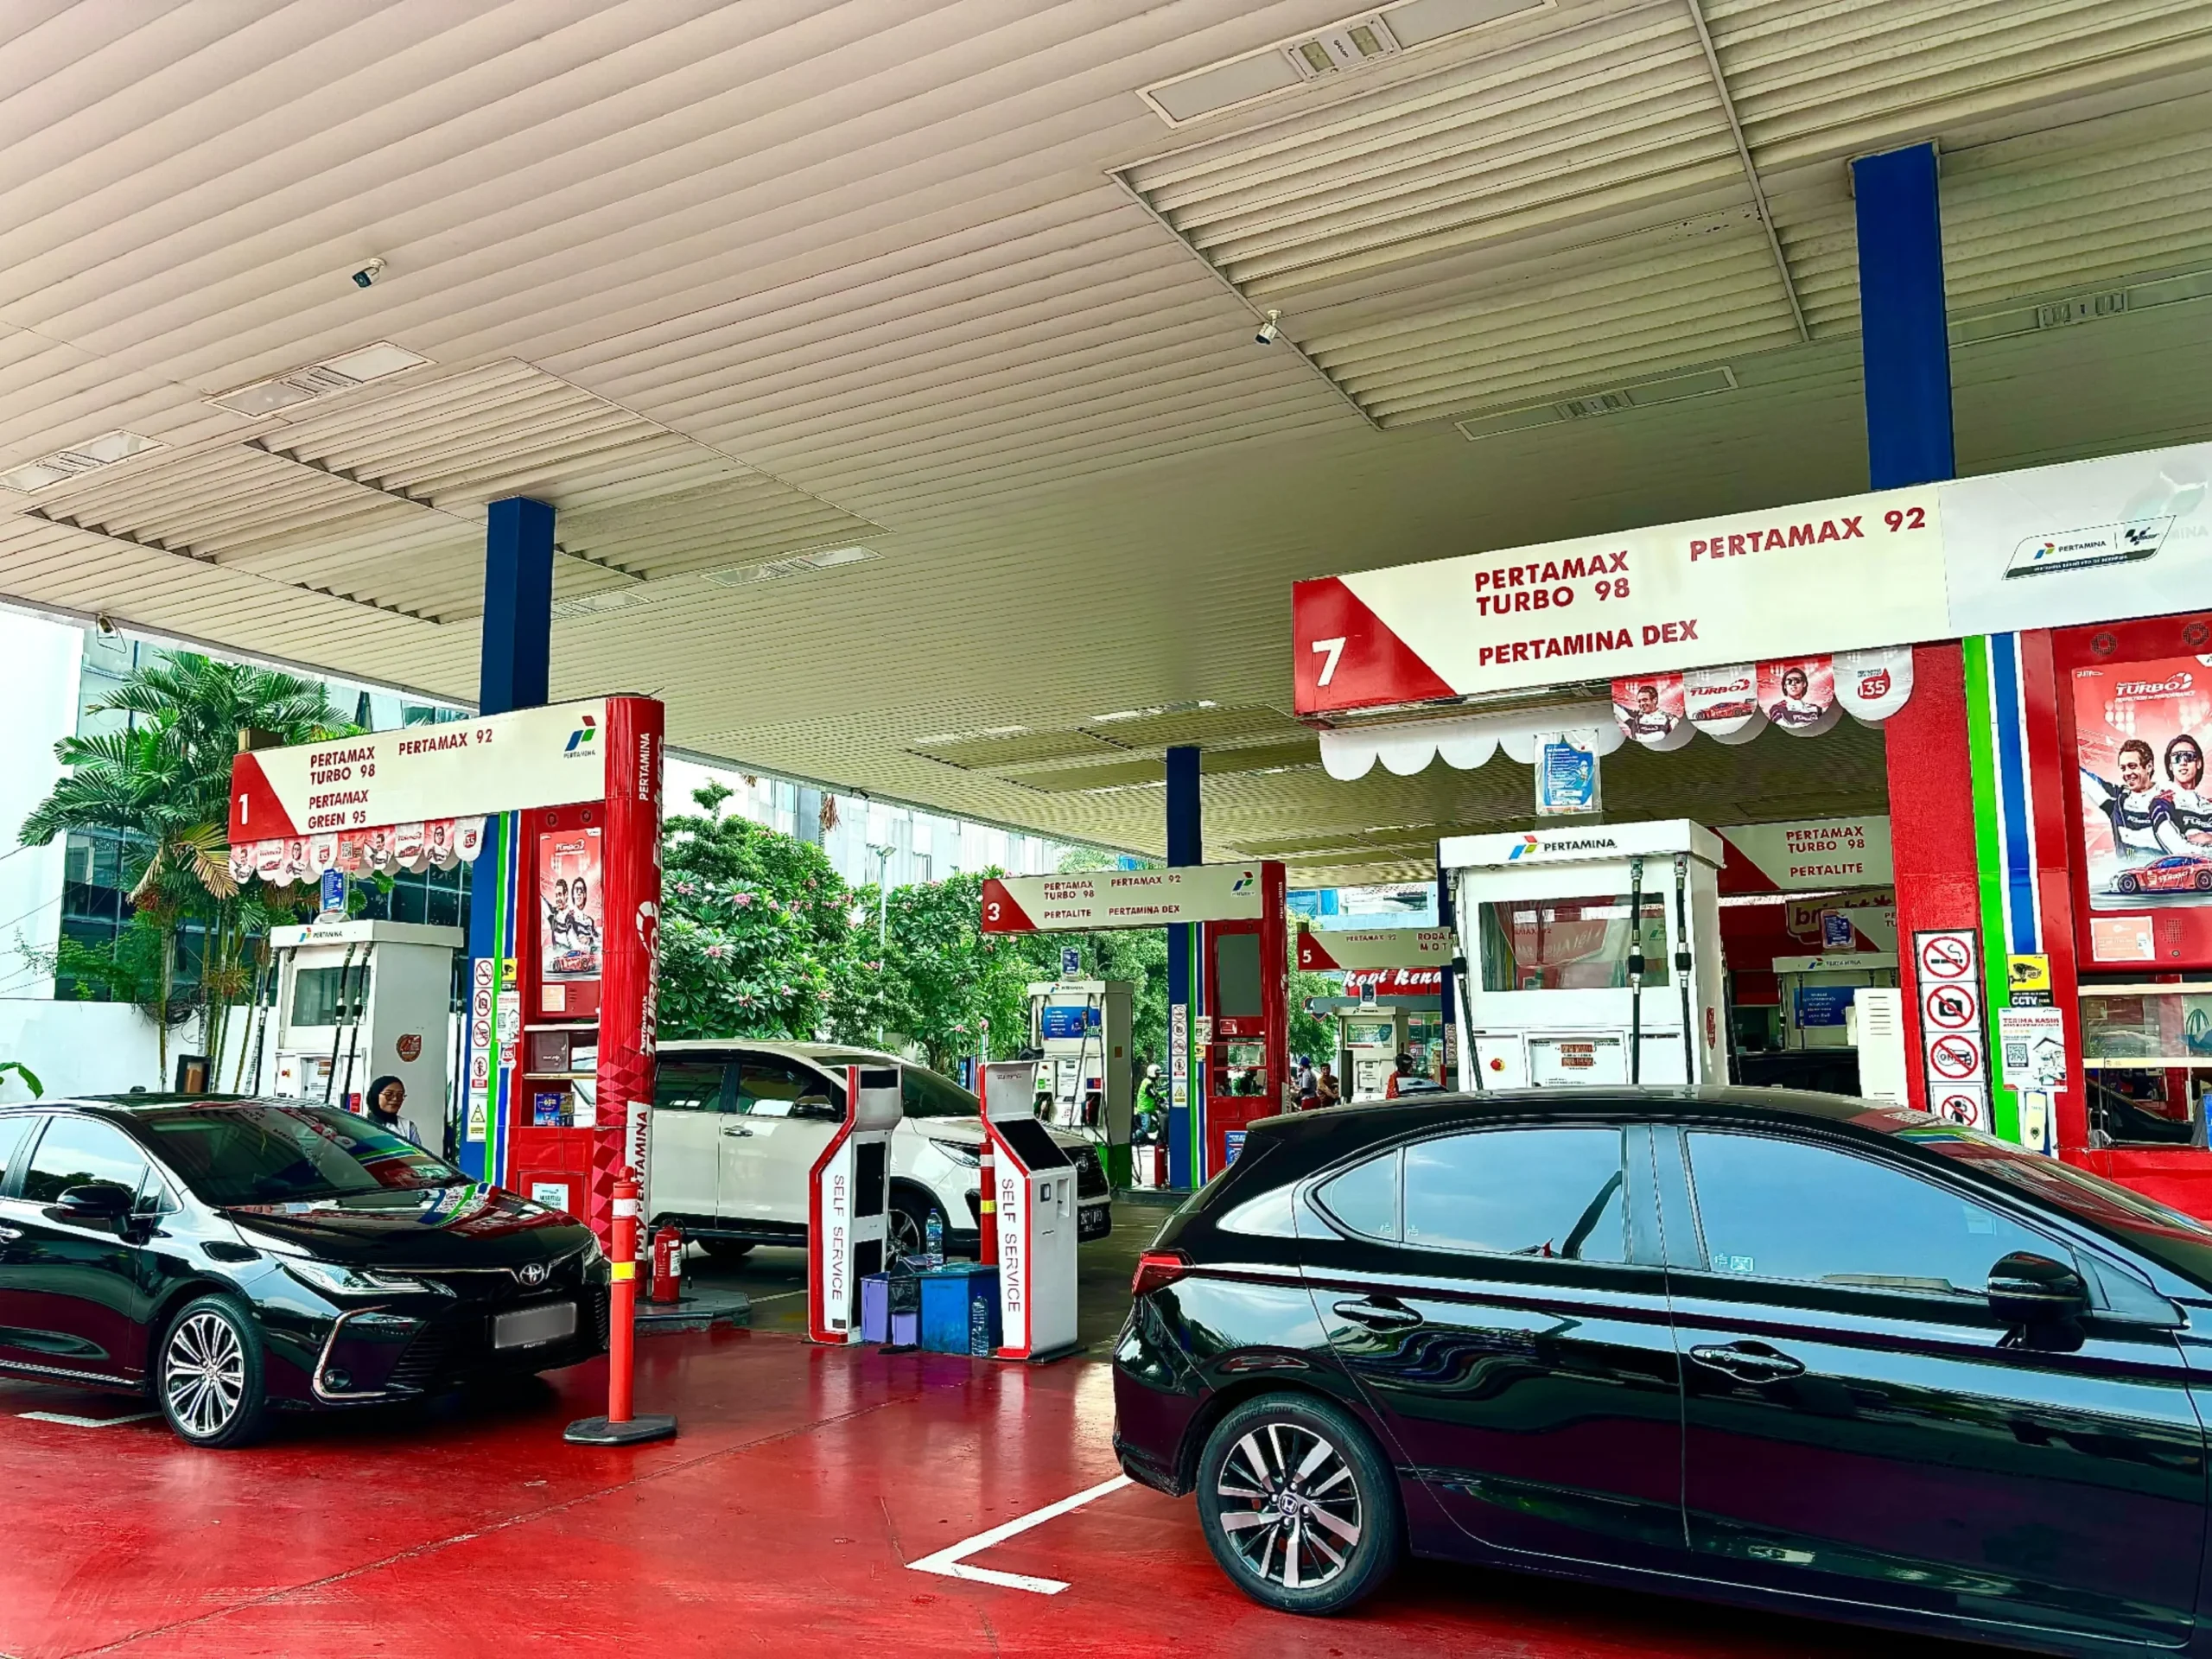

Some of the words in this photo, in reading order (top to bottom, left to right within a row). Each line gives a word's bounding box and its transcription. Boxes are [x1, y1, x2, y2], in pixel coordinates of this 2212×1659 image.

[1689, 516, 1864, 563] PERTAMAX
[1885, 507, 1926, 532] 92
[2059, 541, 2106, 552] PERTAMINA
[1475, 550, 1629, 592] PERTAMAX
[1477, 586, 1574, 616] TURBO
[1595, 577, 1630, 601] 98
[1479, 628, 1634, 666] PERTAMINA
[1643, 620, 1698, 645] DEX
[1313, 637, 1346, 688] 7
[1690, 685, 1741, 696] TURBO
[1859, 680, 1885, 696] 135
[2116, 680, 2180, 696] TURBO
[398, 732, 468, 756] PERTAMAX
[476, 728, 493, 744] 92
[310, 746, 375, 768] PERTAMAX
[639, 733, 650, 801] PERTAMINA
[310, 766, 352, 785] TURBO
[360, 763, 375, 778] 98
[238, 793, 249, 825] 1
[308, 789, 369, 810] PERTAMAX
[308, 811, 346, 830] GREEN
[353, 810, 366, 824] 95
[1786, 826, 1864, 841] PERTAMAX
[1543, 838, 1615, 853] PERTAMINA
[1788, 841, 1837, 854] TURBO
[1847, 839, 1865, 849] 98
[1110, 875, 1162, 887] PERTAMAX
[1168, 874, 1181, 883] 92
[1789, 863, 1864, 878] PERTALITE
[1044, 880, 1093, 891] PERTAMAX
[1044, 891, 1076, 900] TURBO
[988, 902, 1001, 921] 3
[1044, 909, 1091, 918] PERTALITE
[1109, 907, 1160, 916] PERTAMINA
[1302, 950, 1312, 963] 5
[2012, 996, 2037, 1006] CCTV
[635, 1111, 648, 1213] PERTAMINA
[833, 1174, 844, 1217] SELF
[1001, 1179, 1016, 1224] SELF
[832, 1226, 843, 1301] SERVICE
[1005, 1233, 1020, 1313] SERVICE
